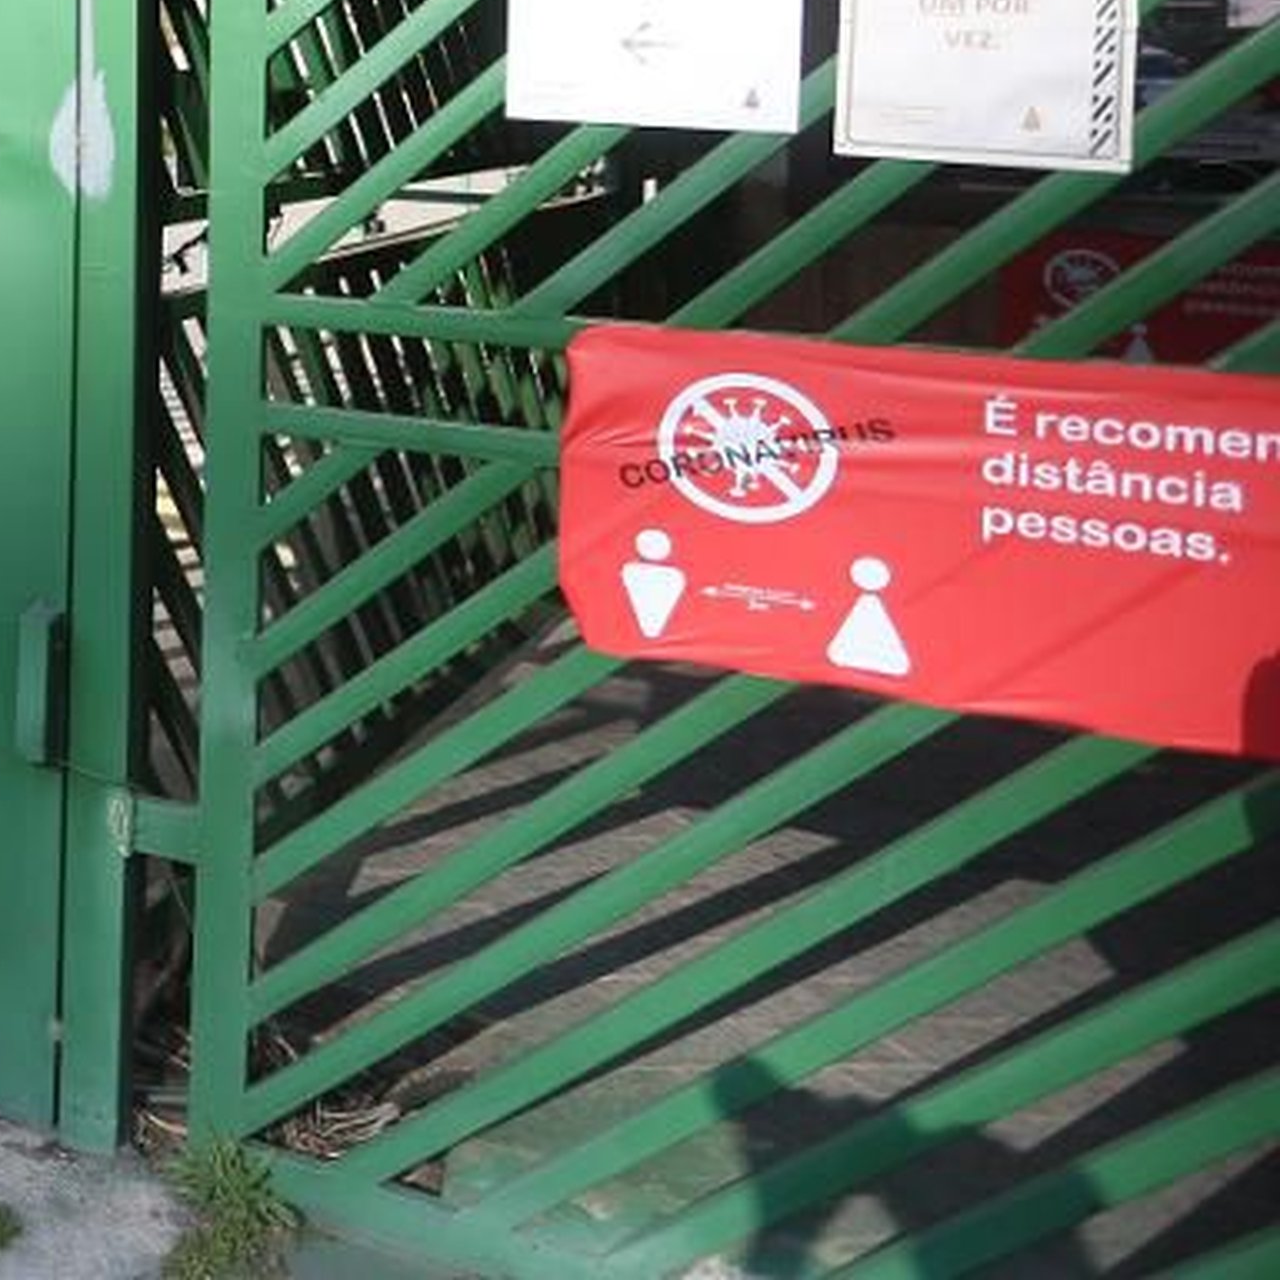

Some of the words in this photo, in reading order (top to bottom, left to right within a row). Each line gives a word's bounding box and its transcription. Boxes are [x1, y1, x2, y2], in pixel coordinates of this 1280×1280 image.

[984, 393, 1018, 437] É
[981, 451, 1243, 513] distância
[981, 505, 1230, 565] pessoas.
